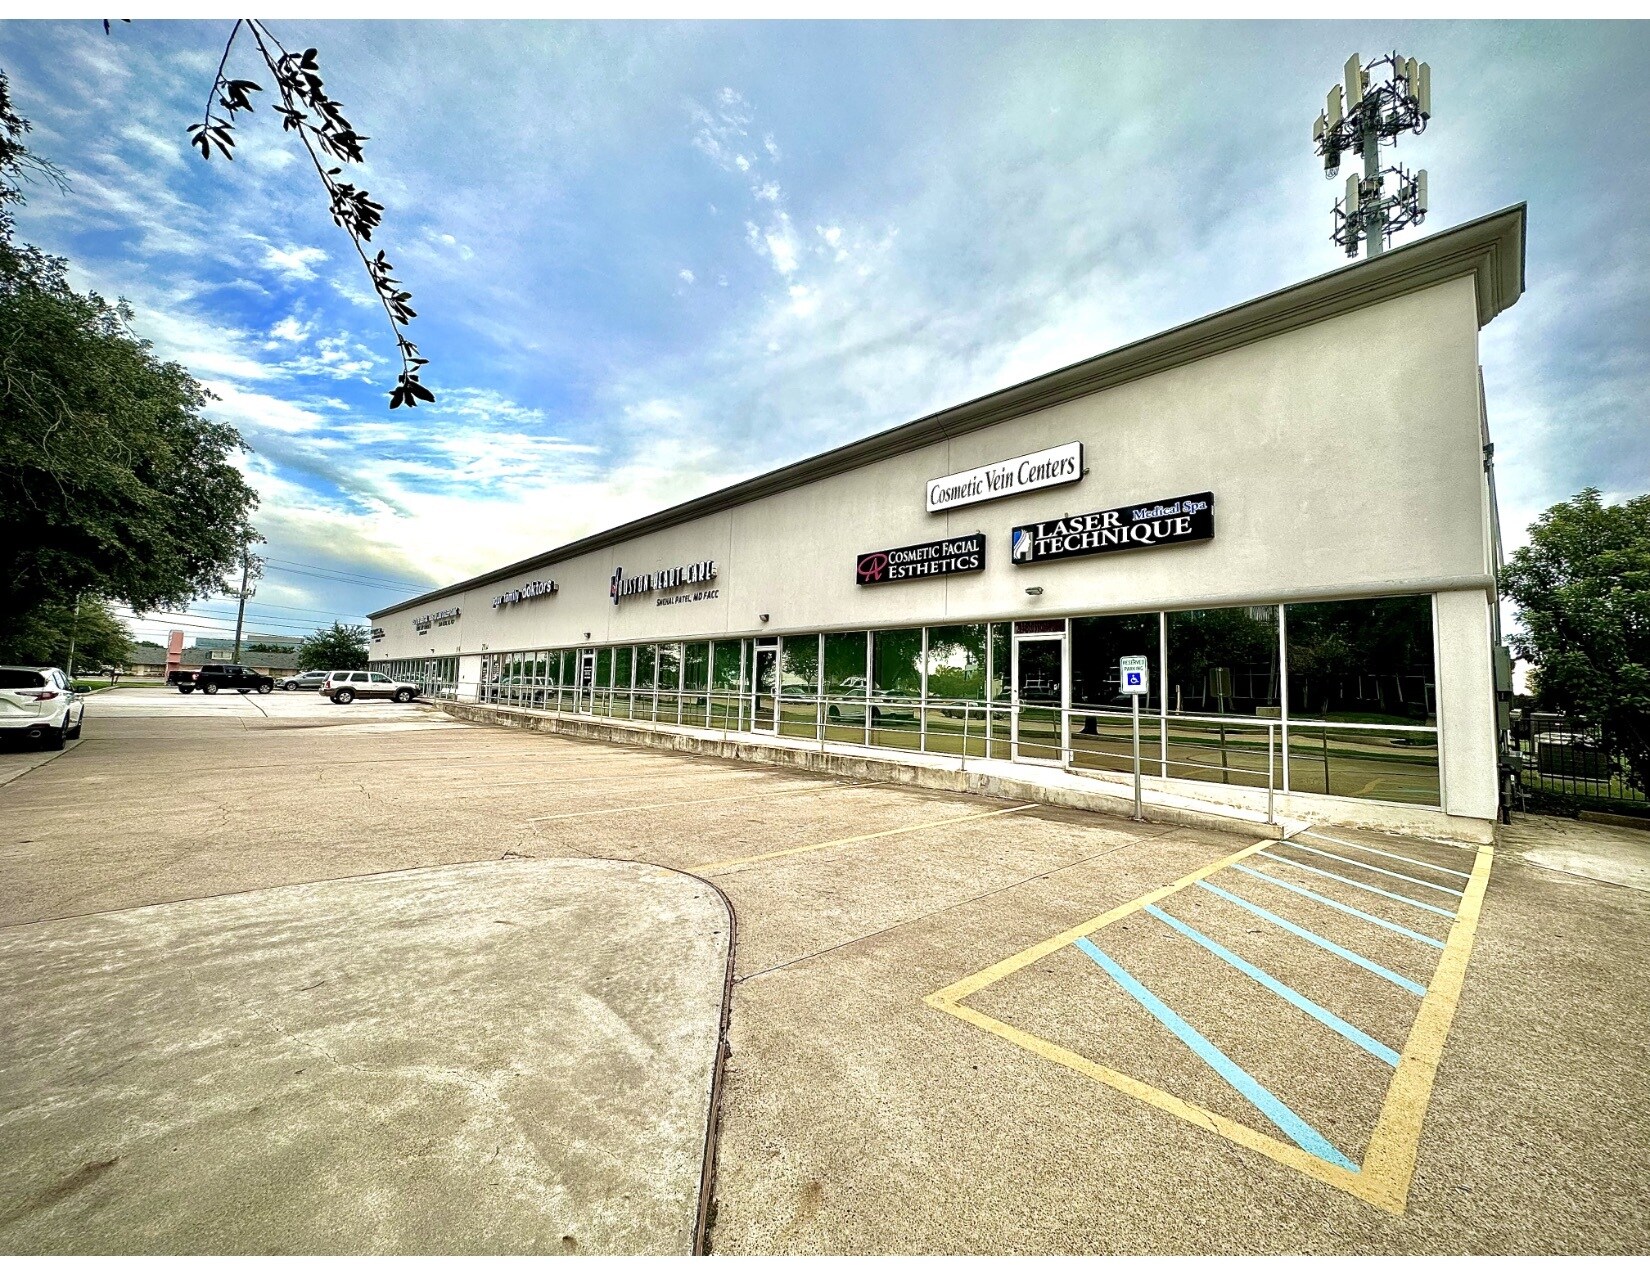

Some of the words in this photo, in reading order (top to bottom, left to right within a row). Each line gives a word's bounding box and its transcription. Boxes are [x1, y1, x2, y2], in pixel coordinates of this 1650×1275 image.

[930, 475, 983, 506] Cosmetic
[985, 466, 1014, 493] Vein
[1017, 456, 1075, 485] Centers
[1132, 502, 1180, 521] Medical
[1182, 500, 1207, 515] Spa
[1034, 516, 1193, 556] TECHNIQUE
[1036, 511, 1123, 540] LASER
[888, 545, 940, 565] COSMETIC
[942, 539, 980, 556] FACIAL
[652, 567, 683, 590] HEART
[686, 560, 718, 583] CARE
[888, 554, 979, 579] ESTHETICS
[703, 589, 720, 600] FACC
